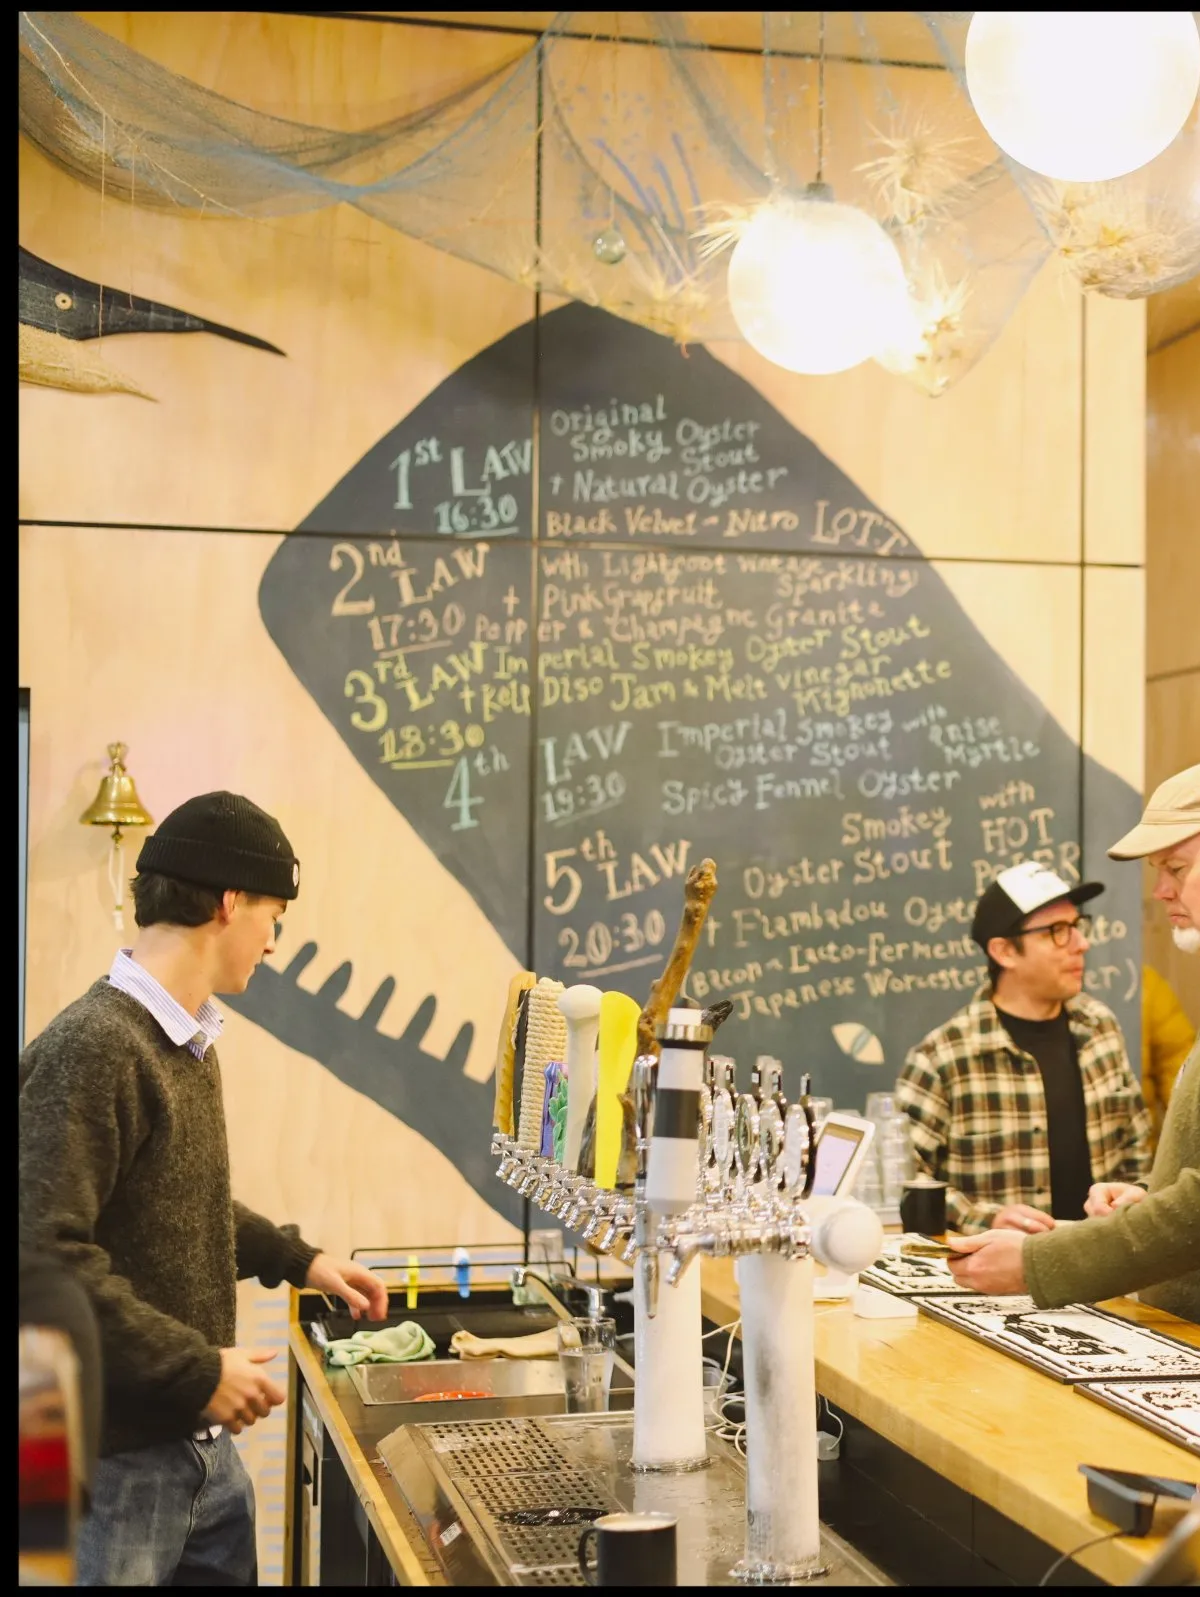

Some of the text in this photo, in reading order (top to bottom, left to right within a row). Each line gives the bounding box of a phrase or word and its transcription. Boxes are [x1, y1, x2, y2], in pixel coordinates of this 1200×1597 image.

[550, 393, 667, 444] Original
[570, 417, 760, 463] Smoky Oyster
[450, 438, 532, 497] LAW
[681, 443, 759, 477] Stout
[573, 469, 679, 501] Natural
[687, 467, 788, 507] Oyster
[434, 494, 518, 534] 16:30
[547, 509, 617, 537] Black
[391, 542, 490, 607] LAW
[542, 583, 604, 619] Pink
[367, 602, 466, 650] 17:30
[631, 641, 735, 673] Smokey
[745, 628, 831, 673] Oyster
[839, 613, 931, 659] Stout
[395, 641, 489, 712] LAW
[609, 673, 676, 711] Jam
[378, 720, 485, 764] 18:30
[657, 707, 788, 758] Imperial
[795, 708, 893, 747] Smokey
[810, 735, 892, 767] Stout
[443, 720, 634, 832] 4th LAW
[542, 769, 627, 822] 19:30
[661, 766, 962, 815] Spicy Fennel Oyster
[978, 779, 1036, 811] with
[841, 805, 1055, 857] Smokey HOT
[543, 829, 692, 916] 5th LAW
[743, 857, 845, 899] Oyster
[852, 838, 953, 885] Stout
[558, 908, 666, 968] 20:30
[903, 896, 978, 933] Oyst
[729, 977, 855, 1020] Japanese
